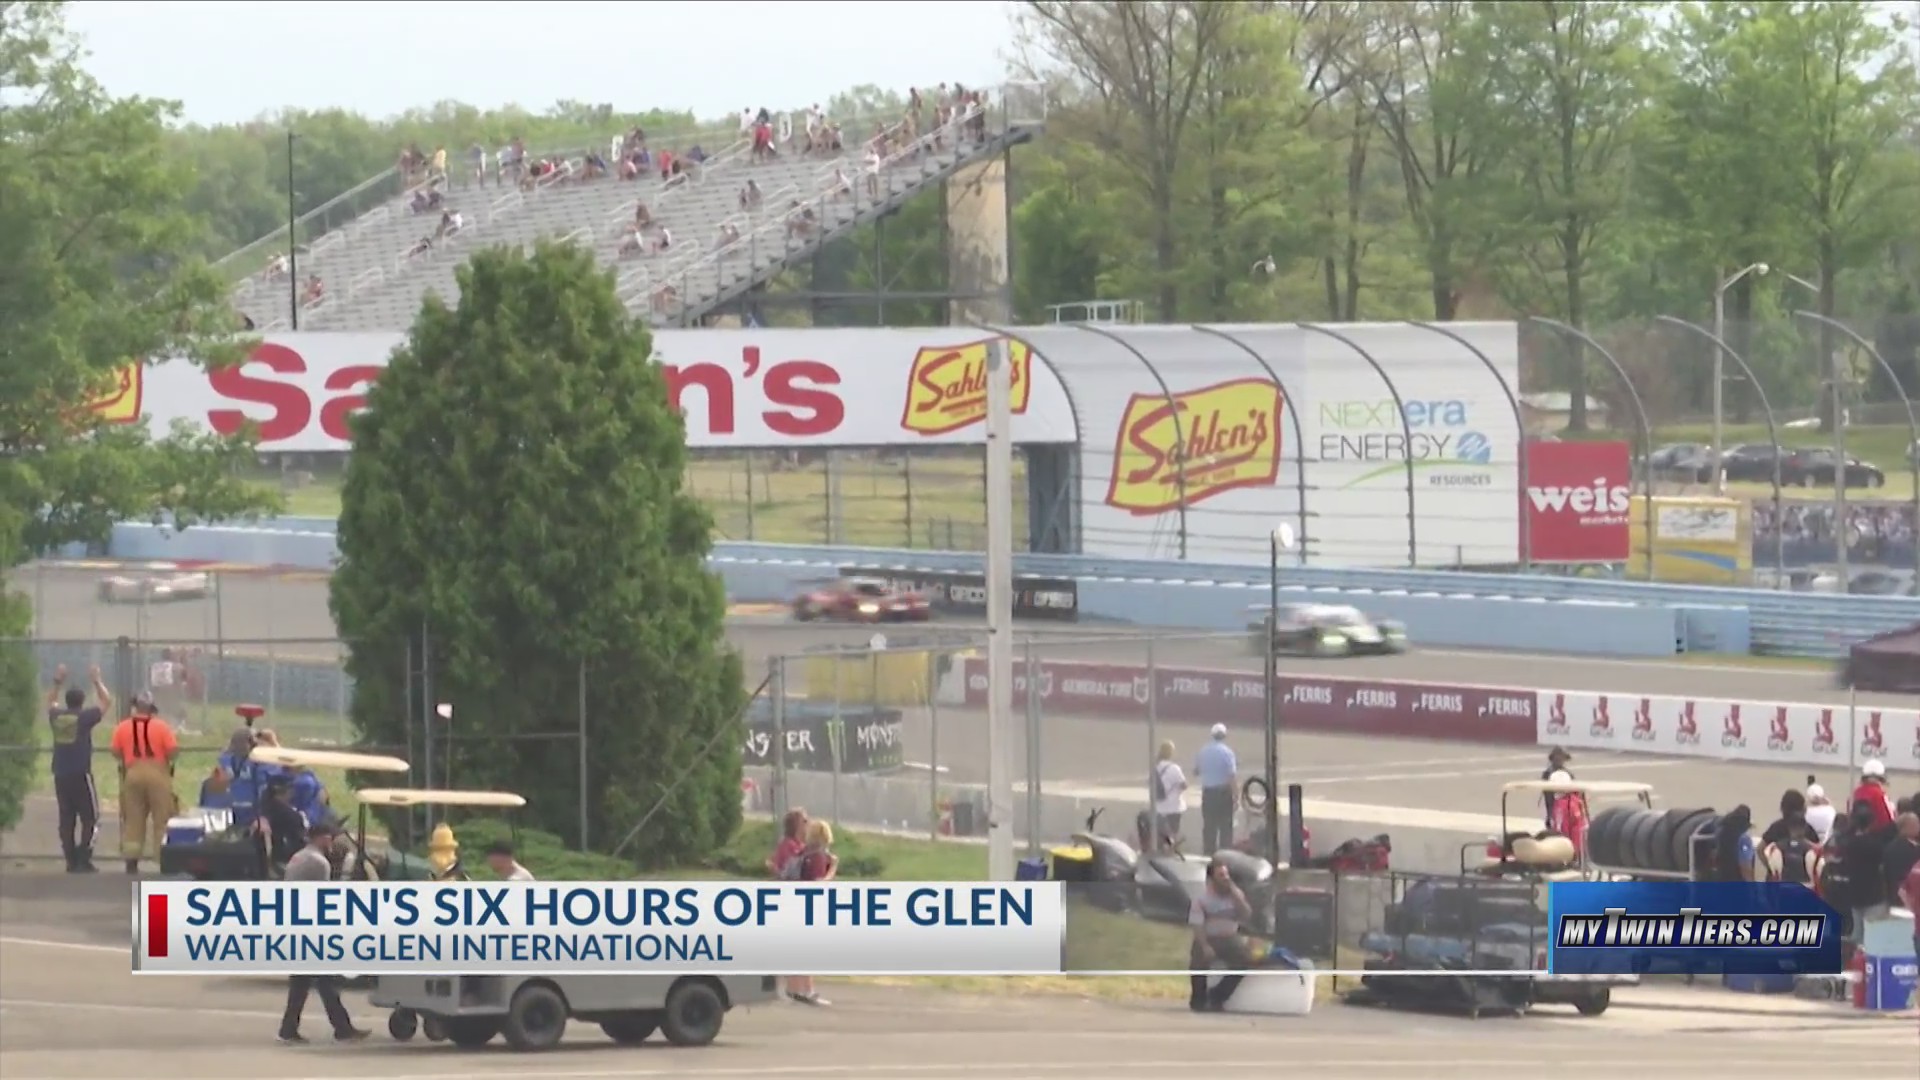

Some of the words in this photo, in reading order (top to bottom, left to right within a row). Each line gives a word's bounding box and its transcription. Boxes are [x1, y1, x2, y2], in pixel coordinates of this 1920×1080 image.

[1320, 433, 1450, 460] ENERGY
[1430, 475, 1492, 486] RESOURCES
[1528, 477, 1629, 512] weis
[1293, 685, 1332, 704] FERRIS
[1356, 689, 1397, 707] FERRIS
[1421, 693, 1463, 711] FERRIS
[1488, 697, 1531, 717] FERRIS
